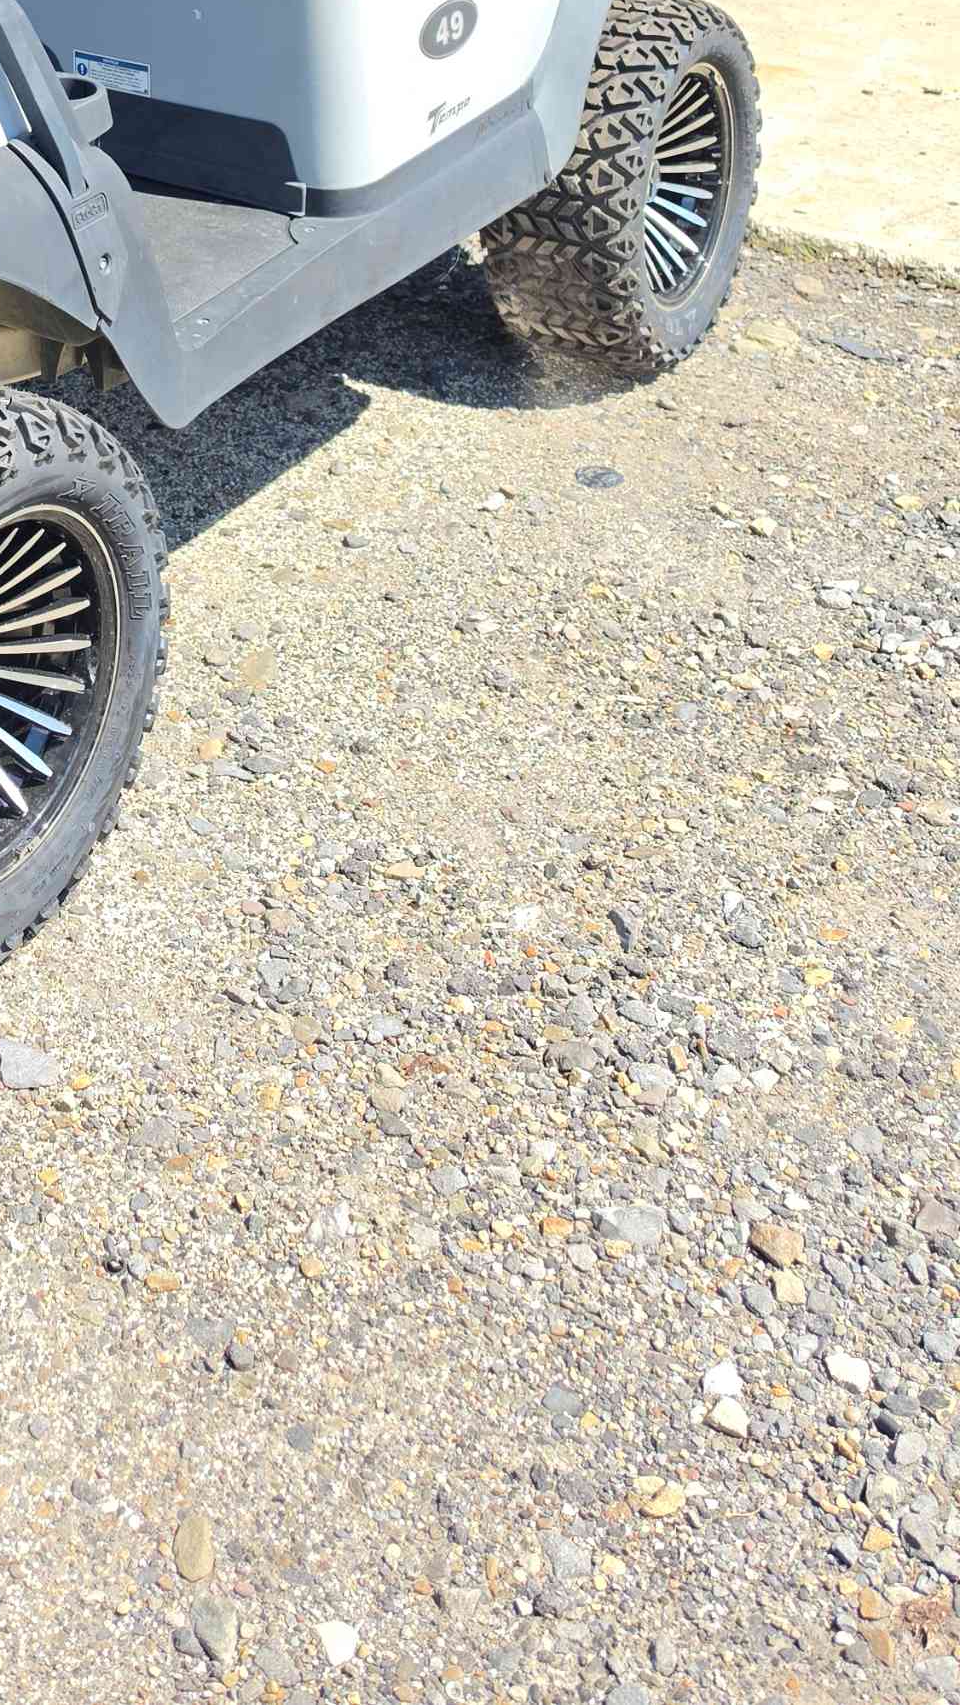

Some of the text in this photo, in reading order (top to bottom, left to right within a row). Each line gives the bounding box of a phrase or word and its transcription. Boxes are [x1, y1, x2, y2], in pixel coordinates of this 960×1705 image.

[436, 10, 464, 45] 49
[426, 96, 471, 135] Tempo
[90, 492, 153, 621] TRAIL
